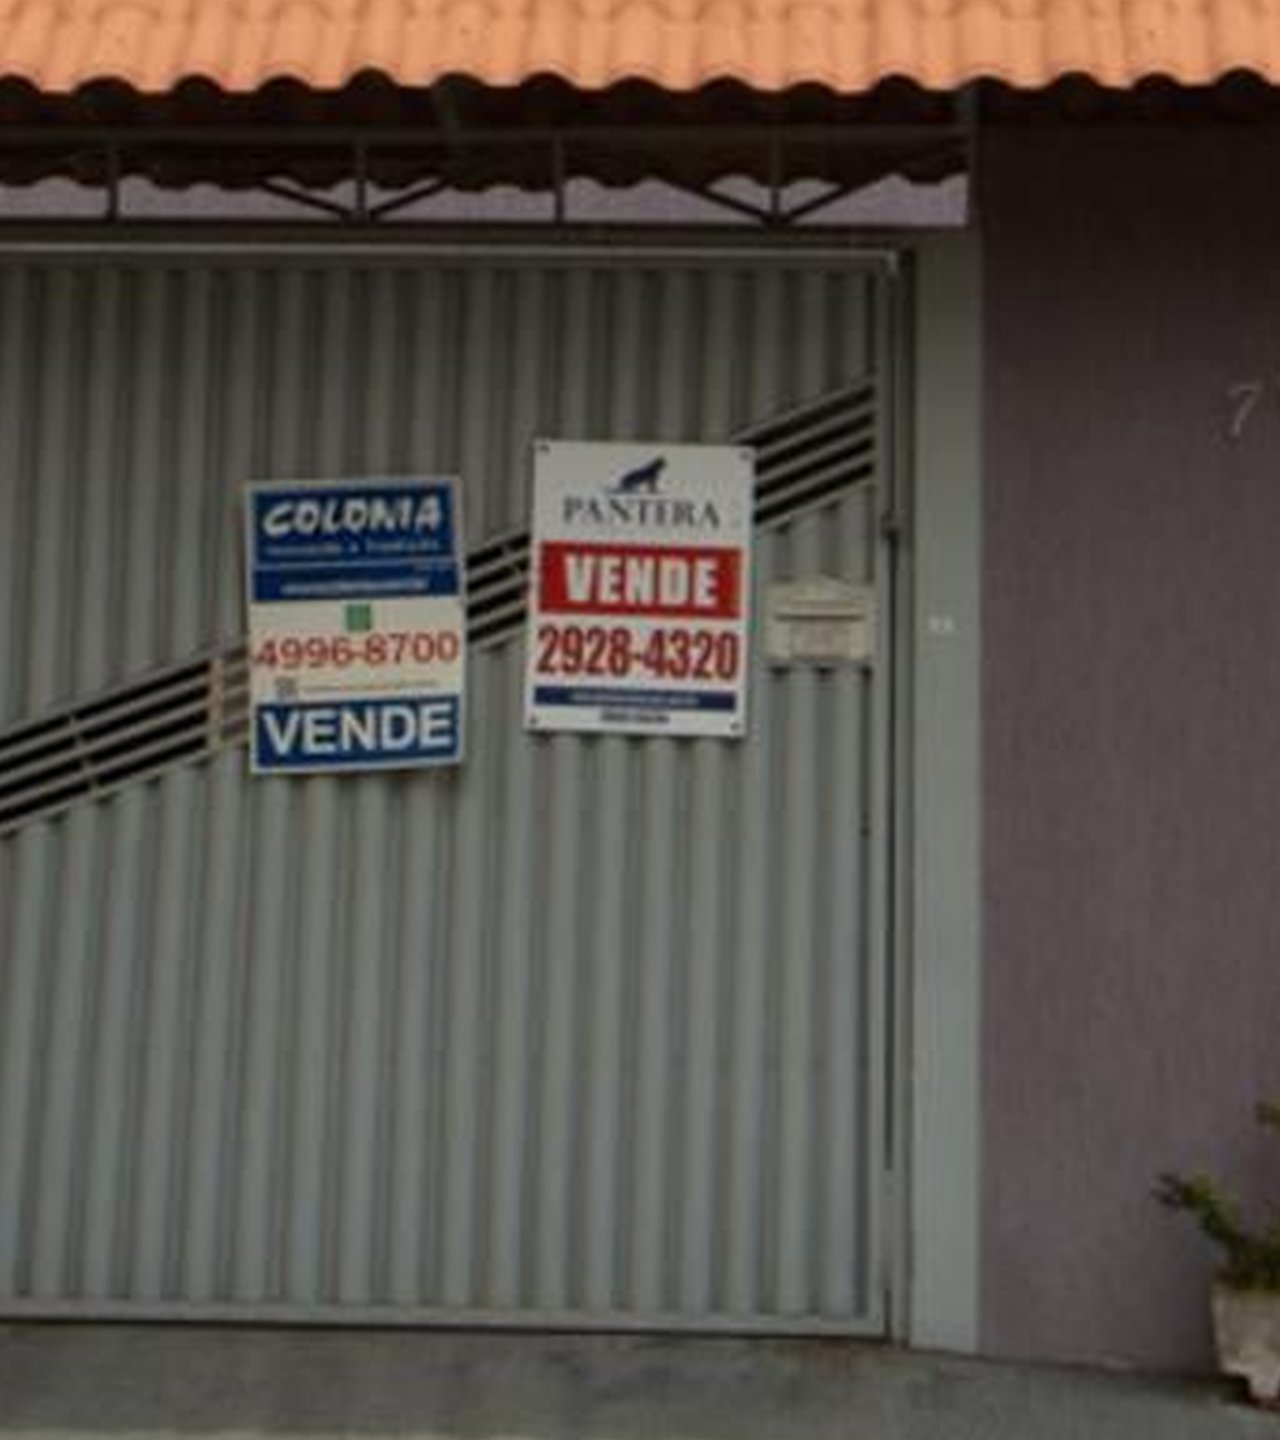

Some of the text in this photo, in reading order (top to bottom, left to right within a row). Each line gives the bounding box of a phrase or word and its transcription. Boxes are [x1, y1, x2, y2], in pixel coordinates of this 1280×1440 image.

[563, 496, 722, 530] PANTERA
[565, 552, 719, 608] VENDE
[256, 630, 460, 669] 4996-8700
[536, 624, 739, 680] 2928-4320
[262, 702, 453, 756] VENDE
